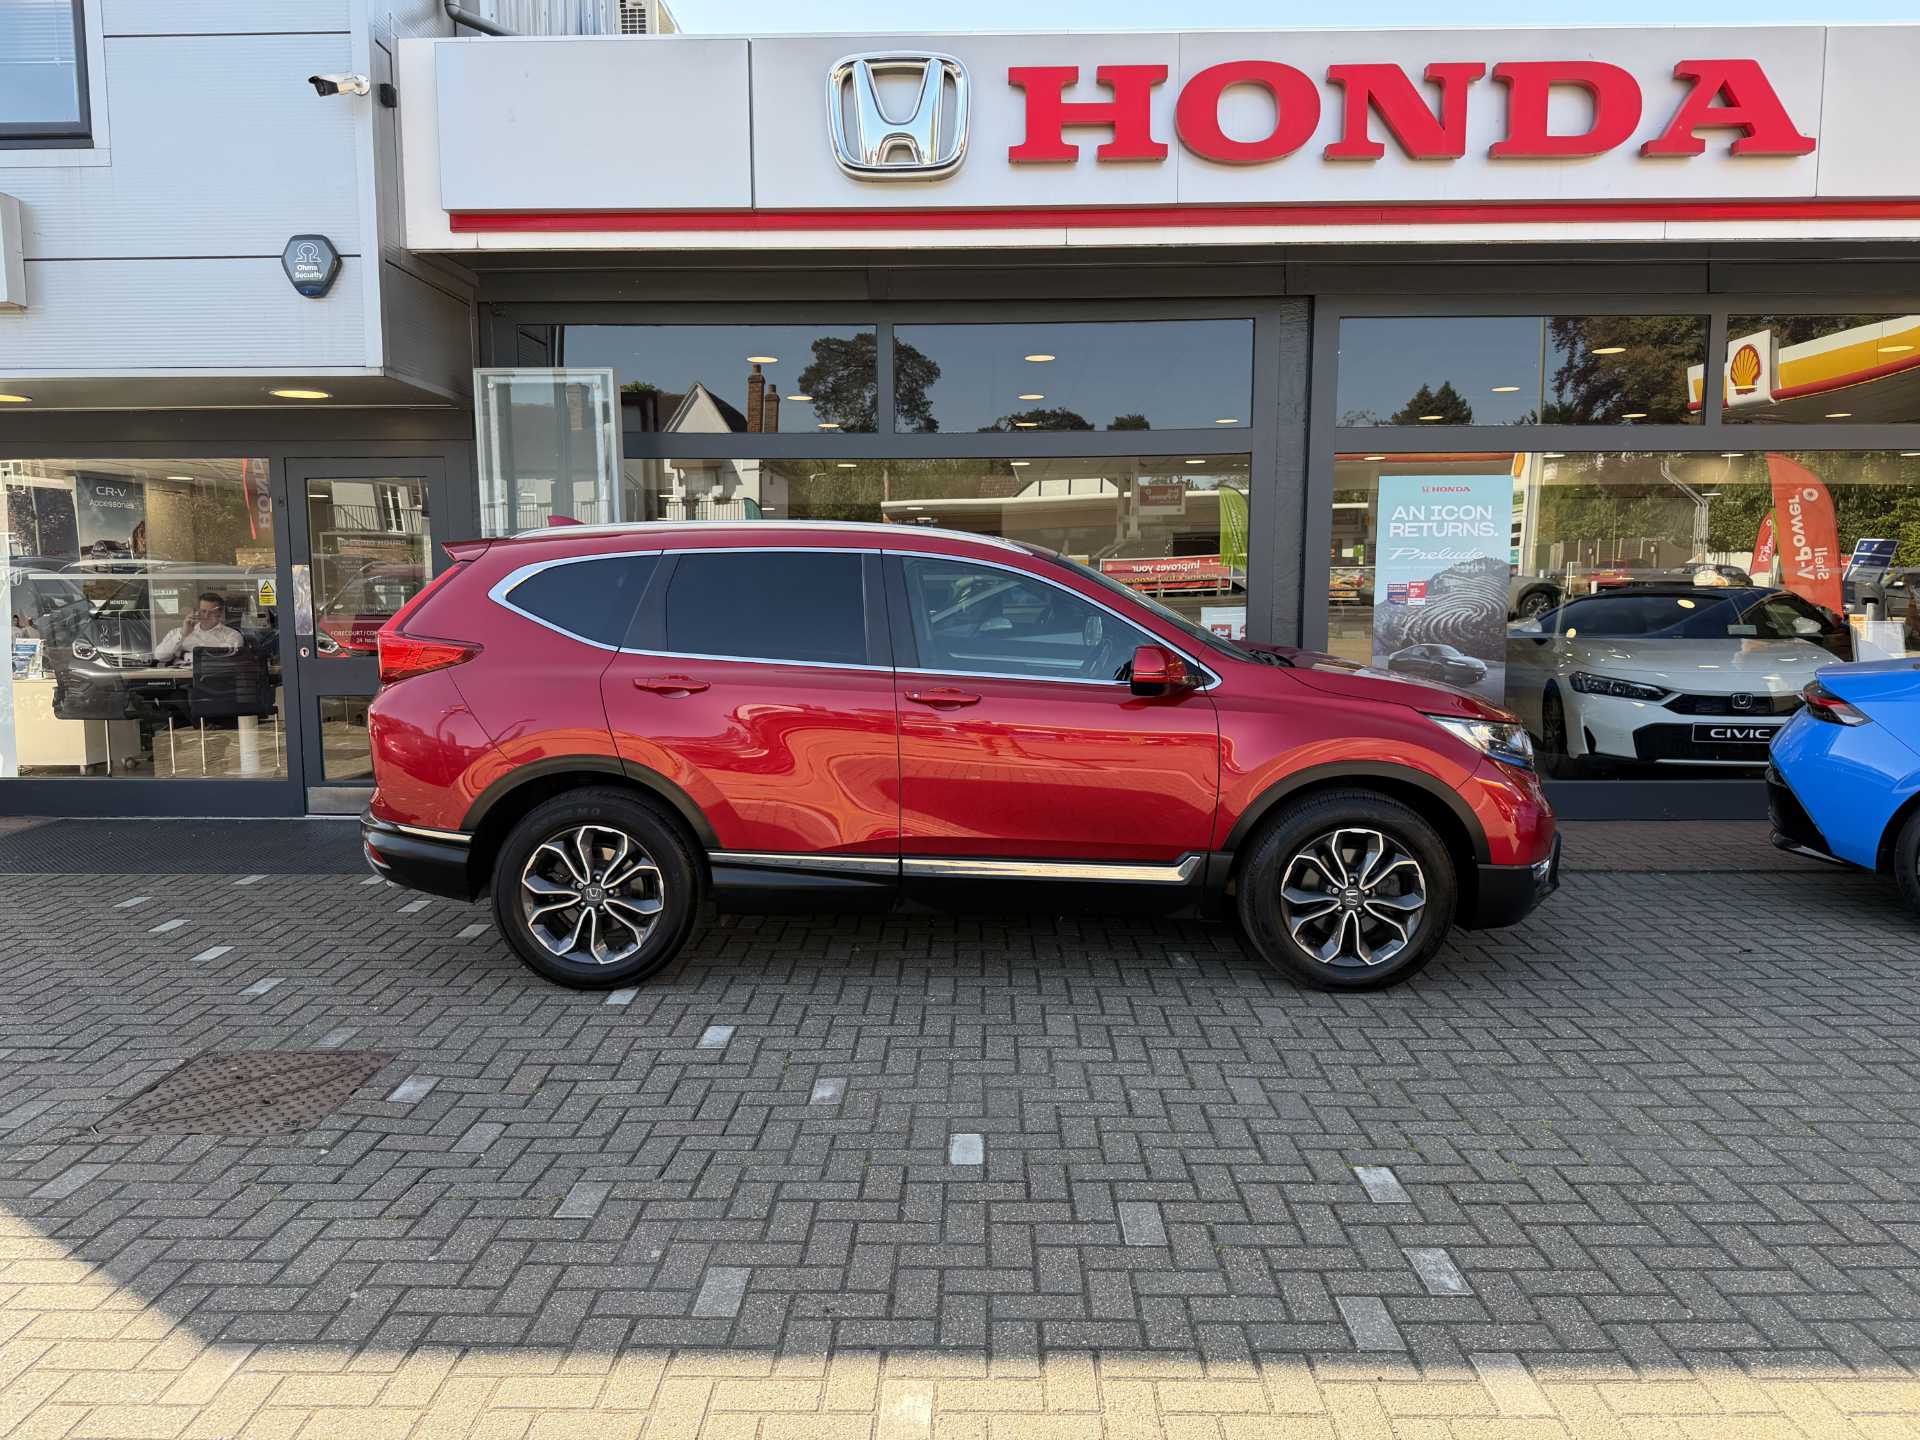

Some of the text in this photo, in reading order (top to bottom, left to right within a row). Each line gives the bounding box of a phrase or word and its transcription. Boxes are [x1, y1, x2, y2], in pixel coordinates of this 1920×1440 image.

[1008, 59, 1817, 164] HONDA
[295, 271, 323, 280] Security
[1431, 486, 1472, 494] HONDA
[89, 499, 138, 510] Accessories
[1392, 505, 1493, 521] AN ICON
[1389, 522, 1499, 537] RETURNS.
[1388, 546, 1487, 561] Prelude
[1710, 728, 1771, 739] CIVIC
